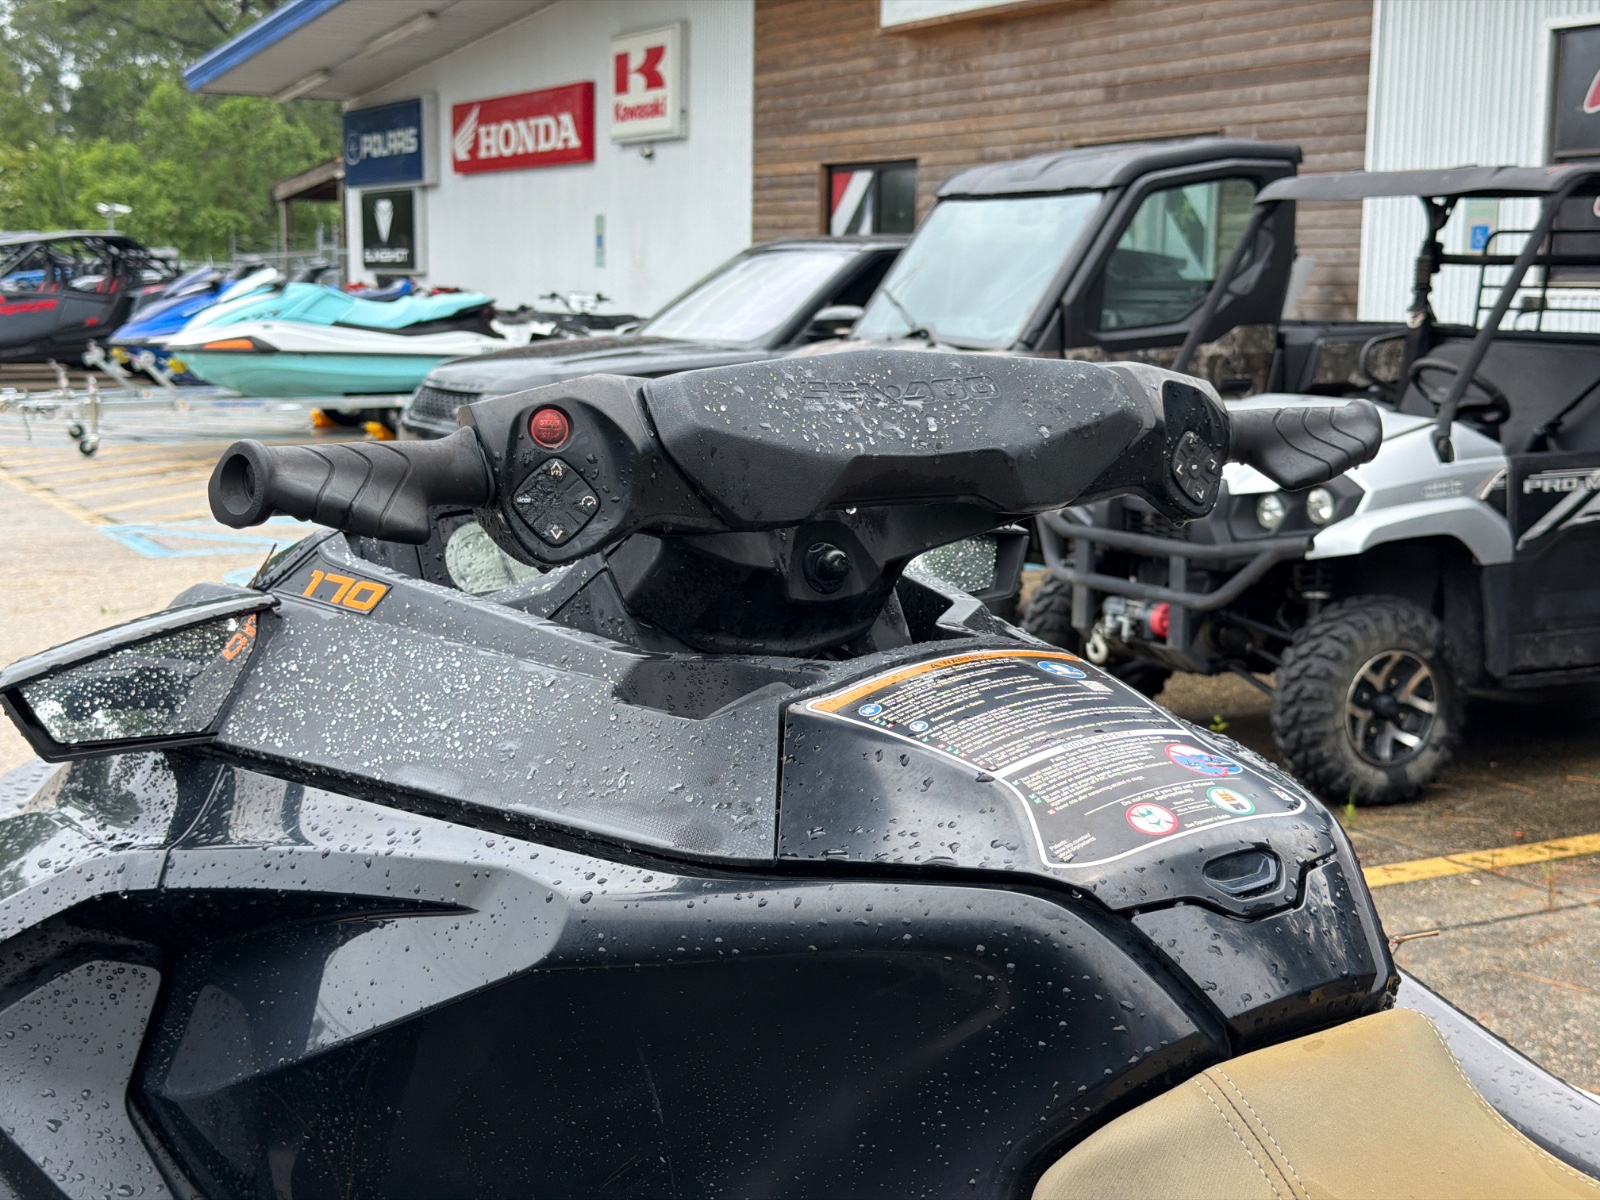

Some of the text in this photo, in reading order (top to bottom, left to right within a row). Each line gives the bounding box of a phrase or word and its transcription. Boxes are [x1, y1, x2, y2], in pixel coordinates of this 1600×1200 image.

[614, 98, 667, 123] Kawasaki
[360, 125, 418, 159] POLARIS
[477, 112, 581, 159] HONDA
[303, 569, 387, 611] 170
[1062, 732, 1132, 750] RIDER SAFETY
